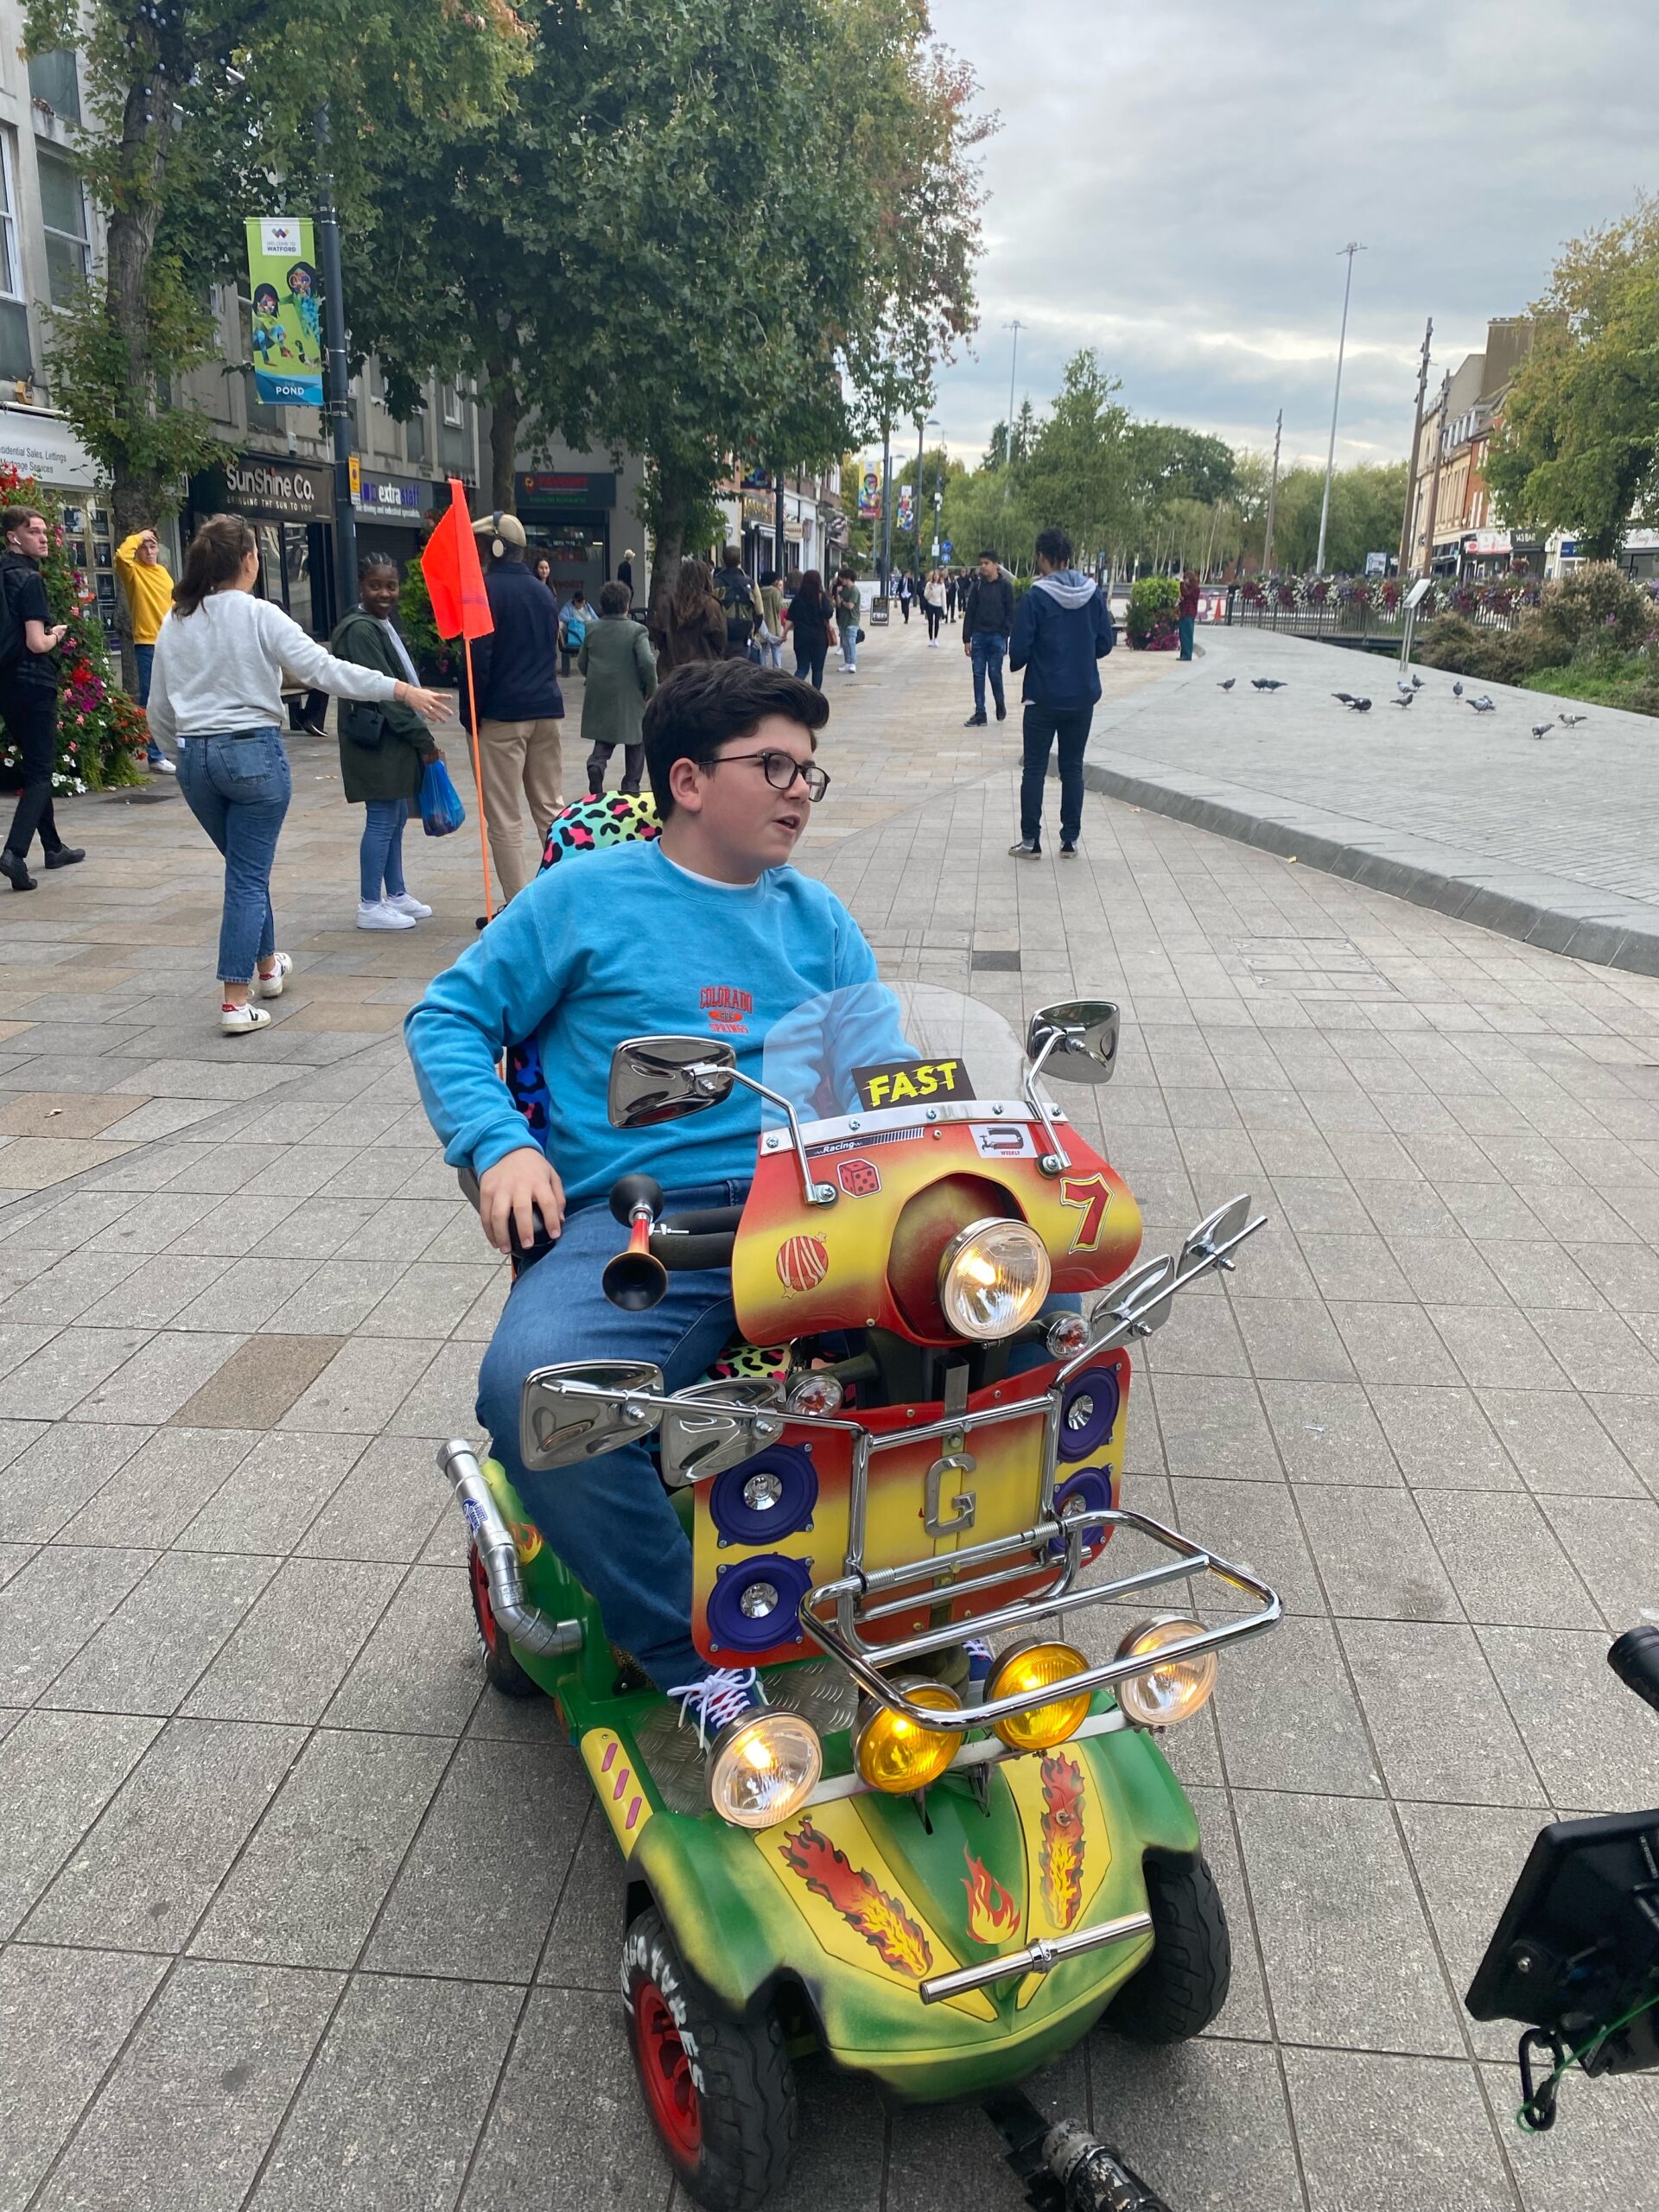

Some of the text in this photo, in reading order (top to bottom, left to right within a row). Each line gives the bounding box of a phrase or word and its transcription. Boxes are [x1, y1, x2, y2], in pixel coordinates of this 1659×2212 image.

[276, 386, 305, 396] POND
[0, 446, 67, 464] sidential Sales, Lettings
[226, 463, 292, 498] SunShine
[294, 474, 315, 500] Co.
[226, 495, 312, 512] BRINGING THE SUN TO YOU
[1525, 532, 1536, 543] BAR
[700, 986, 753, 1014] COLORADO
[709, 1023, 749, 1033] SPRINGS
[862, 1061, 957, 1108] FAST
[823, 1141, 855, 1154] Racing
[1060, 1173, 1114, 1255] 7
[925, 1452, 976, 1537] G
